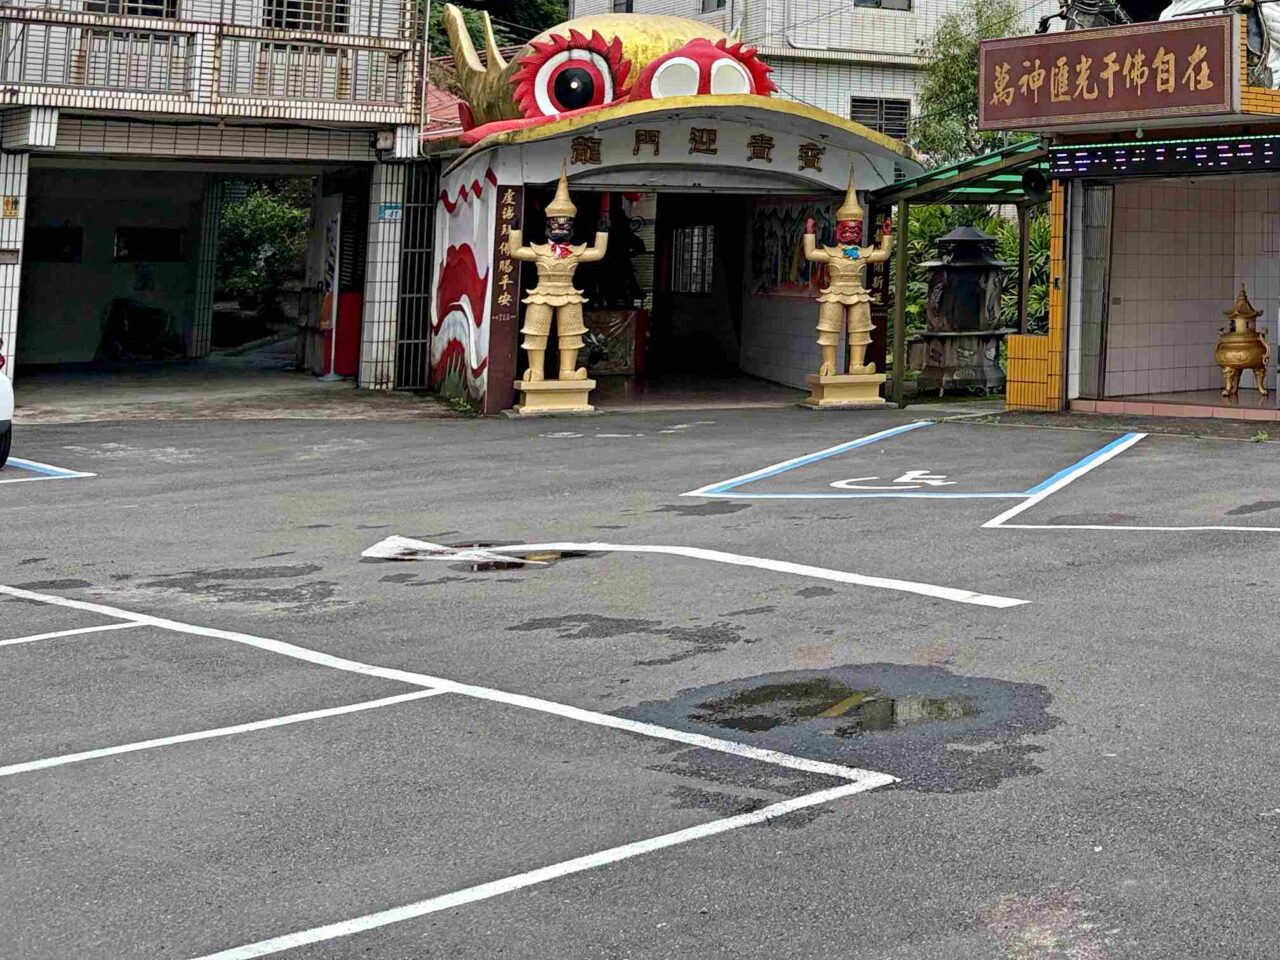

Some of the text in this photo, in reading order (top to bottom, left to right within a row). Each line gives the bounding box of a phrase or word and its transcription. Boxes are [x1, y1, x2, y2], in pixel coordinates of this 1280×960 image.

[570, 128, 823, 172] 龍門迎貴賓
